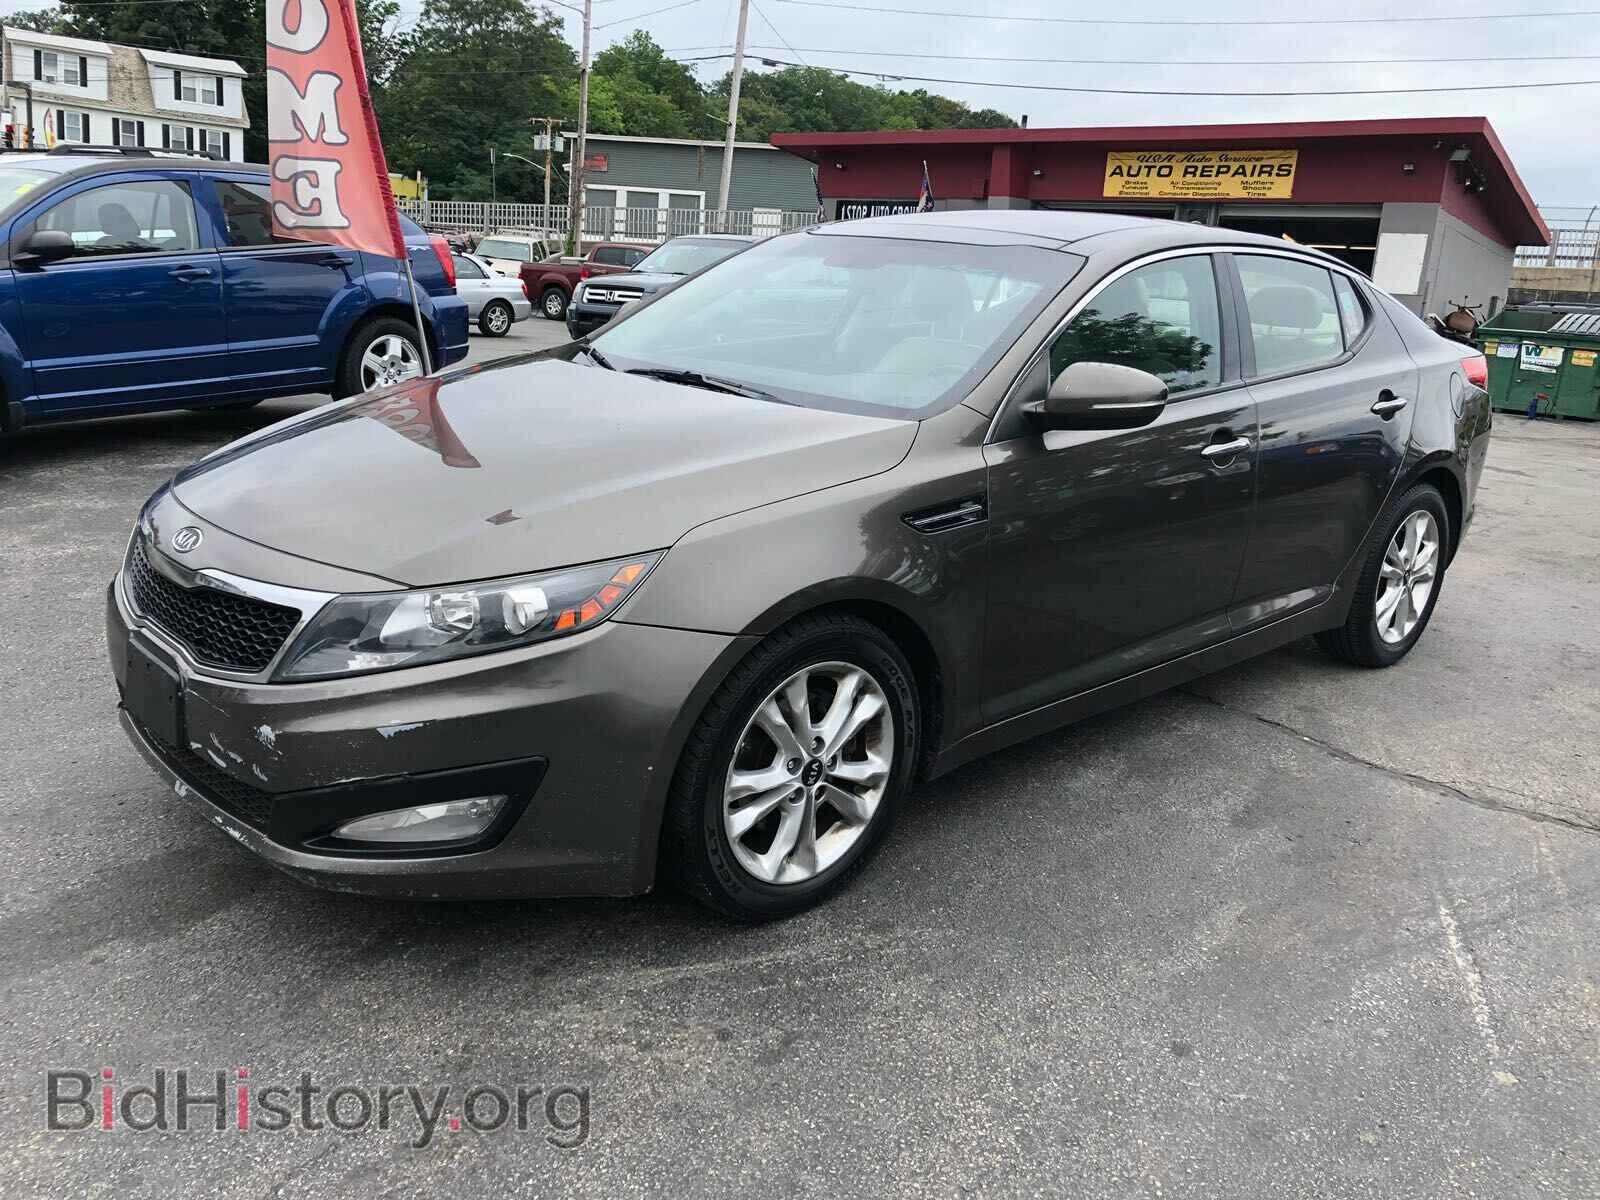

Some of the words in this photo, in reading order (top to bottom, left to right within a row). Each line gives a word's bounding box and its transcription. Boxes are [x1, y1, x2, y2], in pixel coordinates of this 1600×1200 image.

[1177, 153, 1213, 163] Auto
[1217, 152, 1264, 162] Service
[1109, 164, 1174, 178] AUTO
[1182, 163, 1293, 178] REPAIRS
[846, 205, 868, 220] STOP
[870, 205, 889, 217] AUTO
